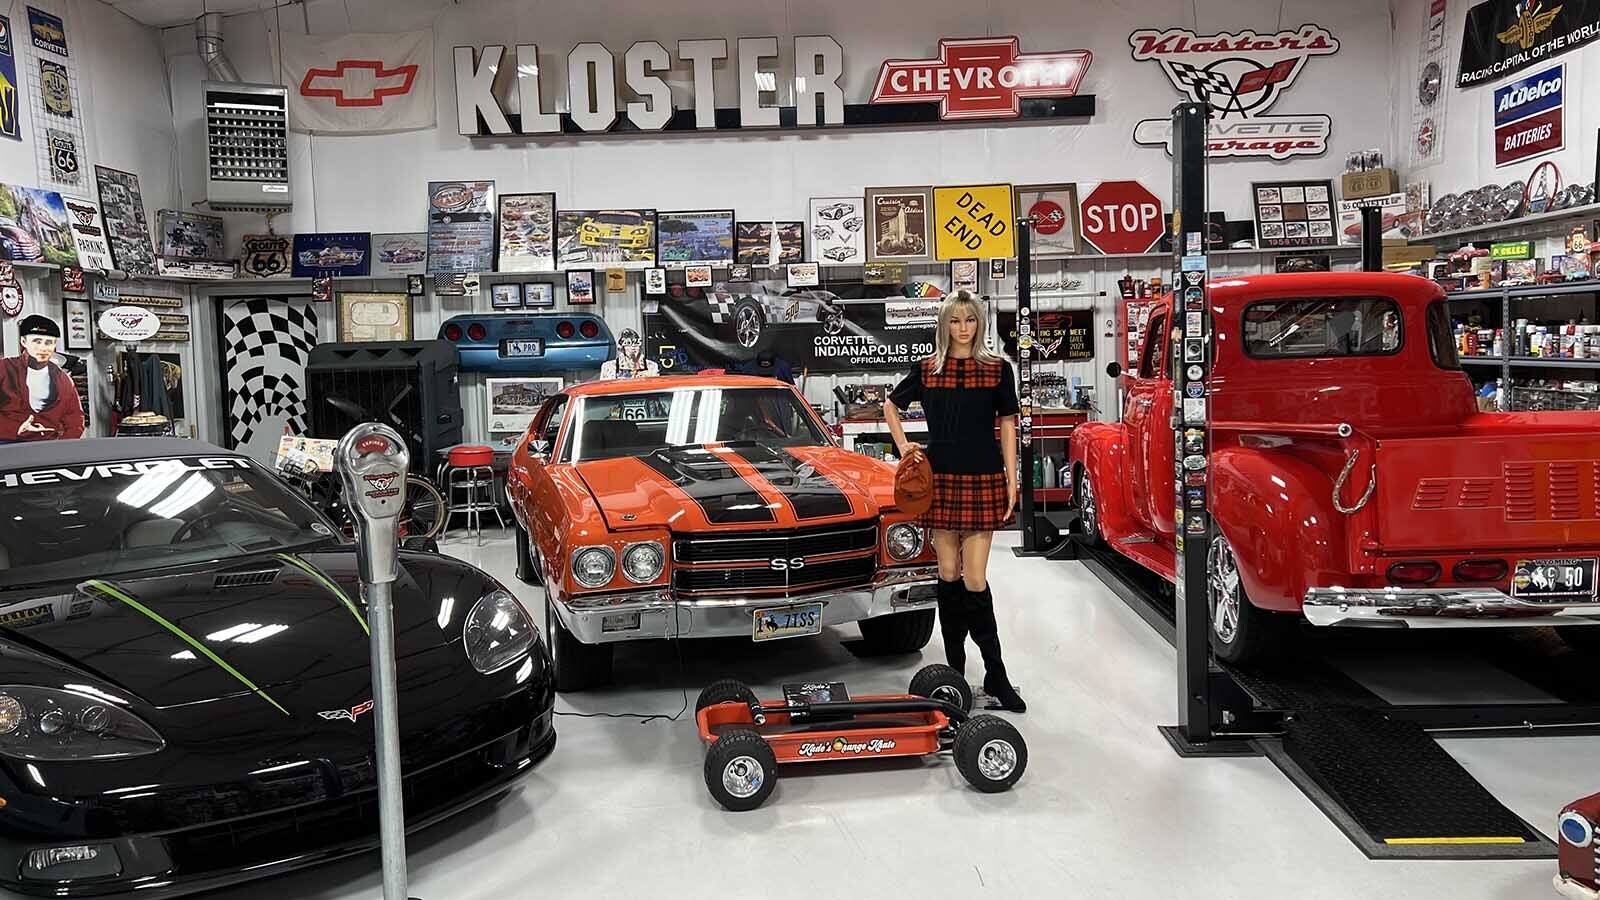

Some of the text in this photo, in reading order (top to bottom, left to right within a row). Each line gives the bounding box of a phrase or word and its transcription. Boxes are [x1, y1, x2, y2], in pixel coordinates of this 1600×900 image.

[34, 38, 68, 56] CORVETTE
[1136, 31, 1334, 55] Kloster's
[1461, 65, 1493, 83] RACING
[1493, 51, 1531, 73] CAPITAL
[1532, 43, 1548, 58] OF
[1546, 36, 1566, 53] THE
[453, 36, 845, 135] KLOSTER
[890, 64, 1071, 92] CHEVROLET
[1498, 77, 1562, 113] ACDelco
[1504, 123, 1553, 152] BATTERIES
[1207, 138, 1321, 154] arage
[57, 151, 75, 168] 66
[956, 192, 1006, 237] DEAD
[1087, 203, 1158, 234] STOP
[944, 216, 983, 251] END
[78, 239, 105, 255] PARKING
[252, 242, 284, 250] ROUTE
[1574, 240, 1583, 250] 66
[88, 256, 103, 269] ONLY
[252, 252, 280, 271] 66
[814, 335, 874, 347] CORVETTE
[1053, 330, 1067, 338] SKY
[523, 343, 537, 352] PRO
[814, 342, 934, 358] INDIANAPOLIS 500
[850, 354, 923, 365] OFFICIAL PACE CA
[625, 408, 646, 421] 66
[771, 556, 805, 570] SS
[1535, 558, 1578, 566] WYOMING
[1565, 566, 1584, 587] 50
